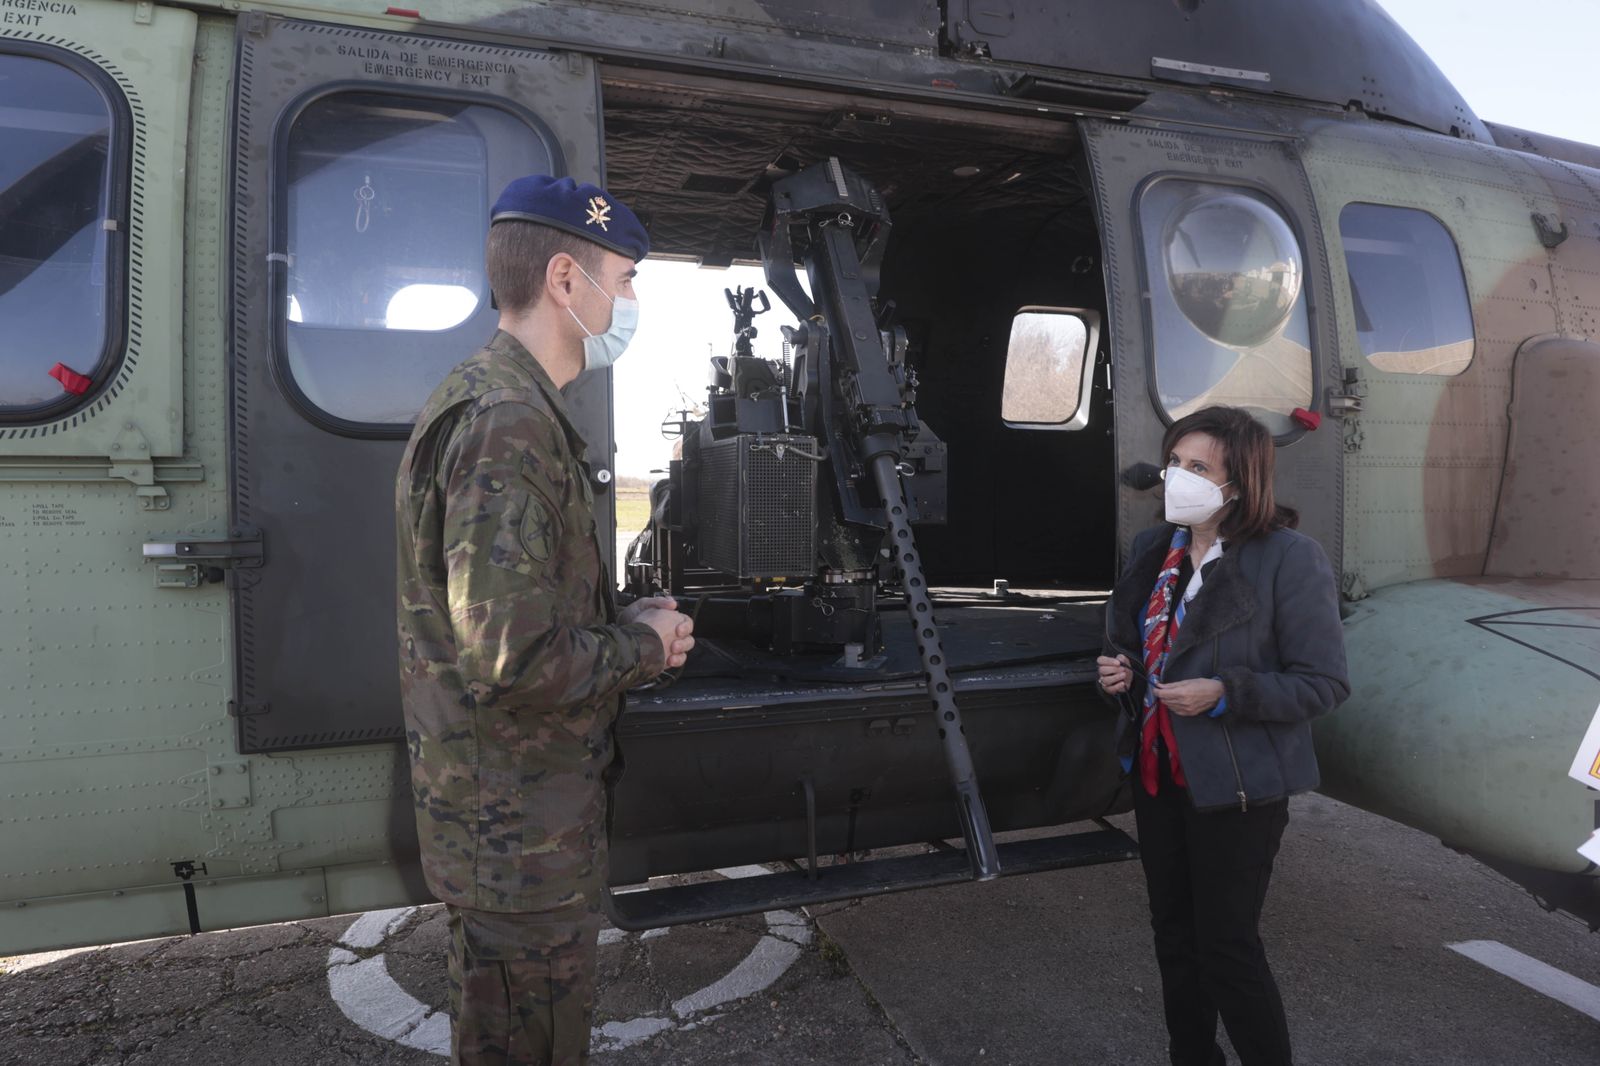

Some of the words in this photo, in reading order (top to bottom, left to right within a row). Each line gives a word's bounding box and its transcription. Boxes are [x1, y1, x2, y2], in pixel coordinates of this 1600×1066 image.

[4, 12, 43, 26] EXIT
[338, 45, 390, 60] SALIDA
[400, 52, 418, 64] DE
[428, 55, 516, 75] EMERGENCIA
[364, 62, 452, 82] EMERGENCY
[461, 73, 491, 86] EXIT
